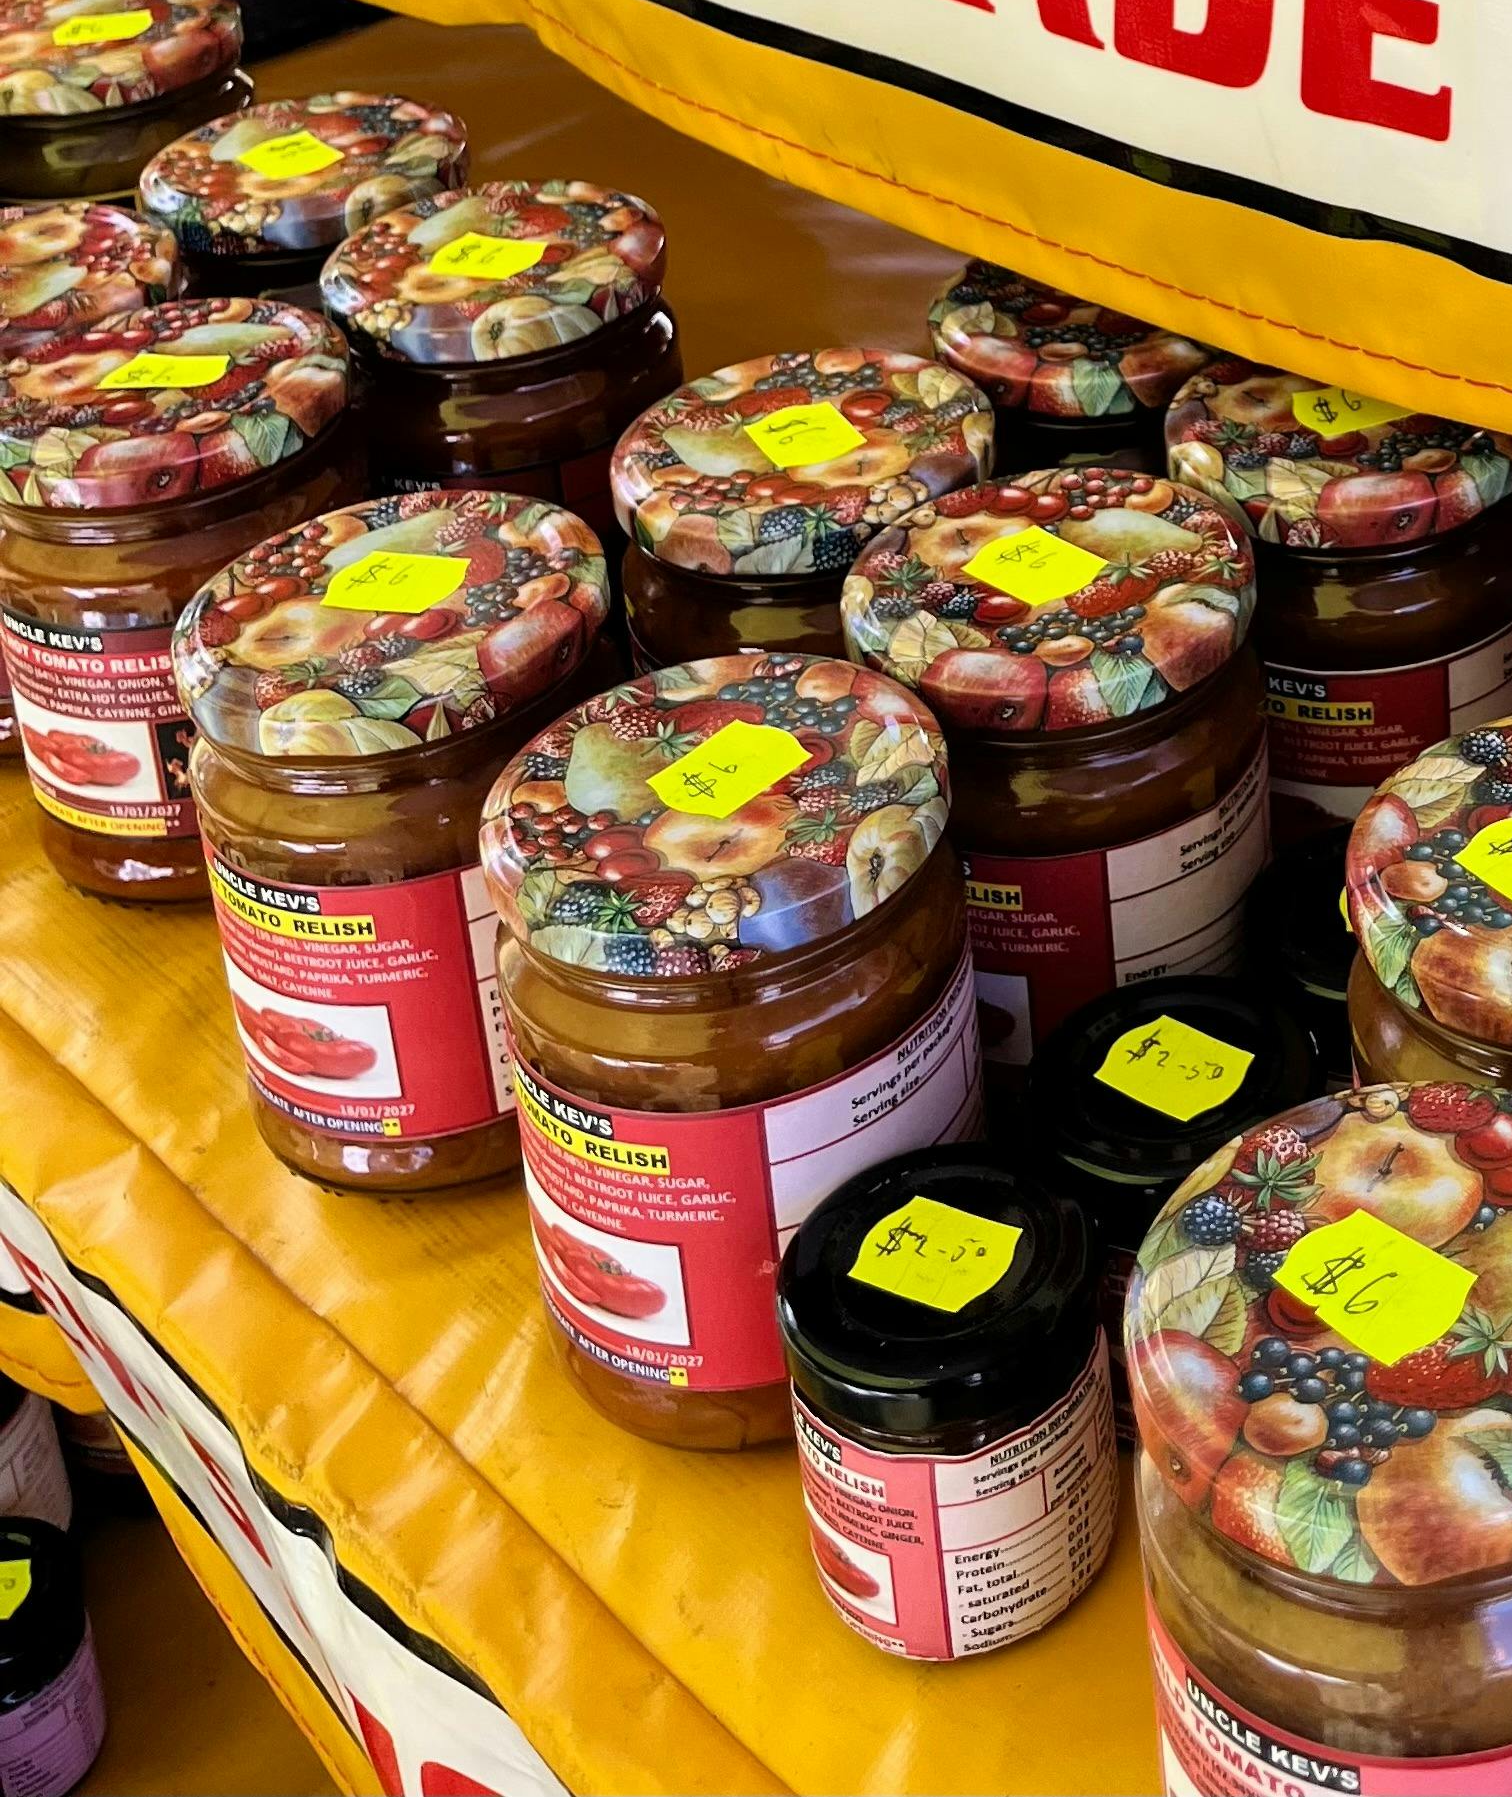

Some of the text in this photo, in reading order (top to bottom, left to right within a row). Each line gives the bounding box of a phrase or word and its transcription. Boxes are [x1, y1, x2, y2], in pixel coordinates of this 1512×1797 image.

[50, 632, 102, 652] KEV'S
[34, 646, 104, 673] TOMATO
[1269, 676, 1326, 698] KEV'S
[1298, 707, 1372, 721] RELISH
[213, 858, 320, 912] UNCLE KEV'S
[222, 885, 373, 936] TOMATO RELISH
[553, 1099, 613, 1136] KEV'S
[585, 1140, 667, 1169] RELISH
[657, 1177, 710, 1189] SUGAR,
[1301, 1246, 1398, 1315] $6
[955, 1548, 1001, 1565] Energy
[1185, 1681, 1360, 1791] UNCLE KEV'S
